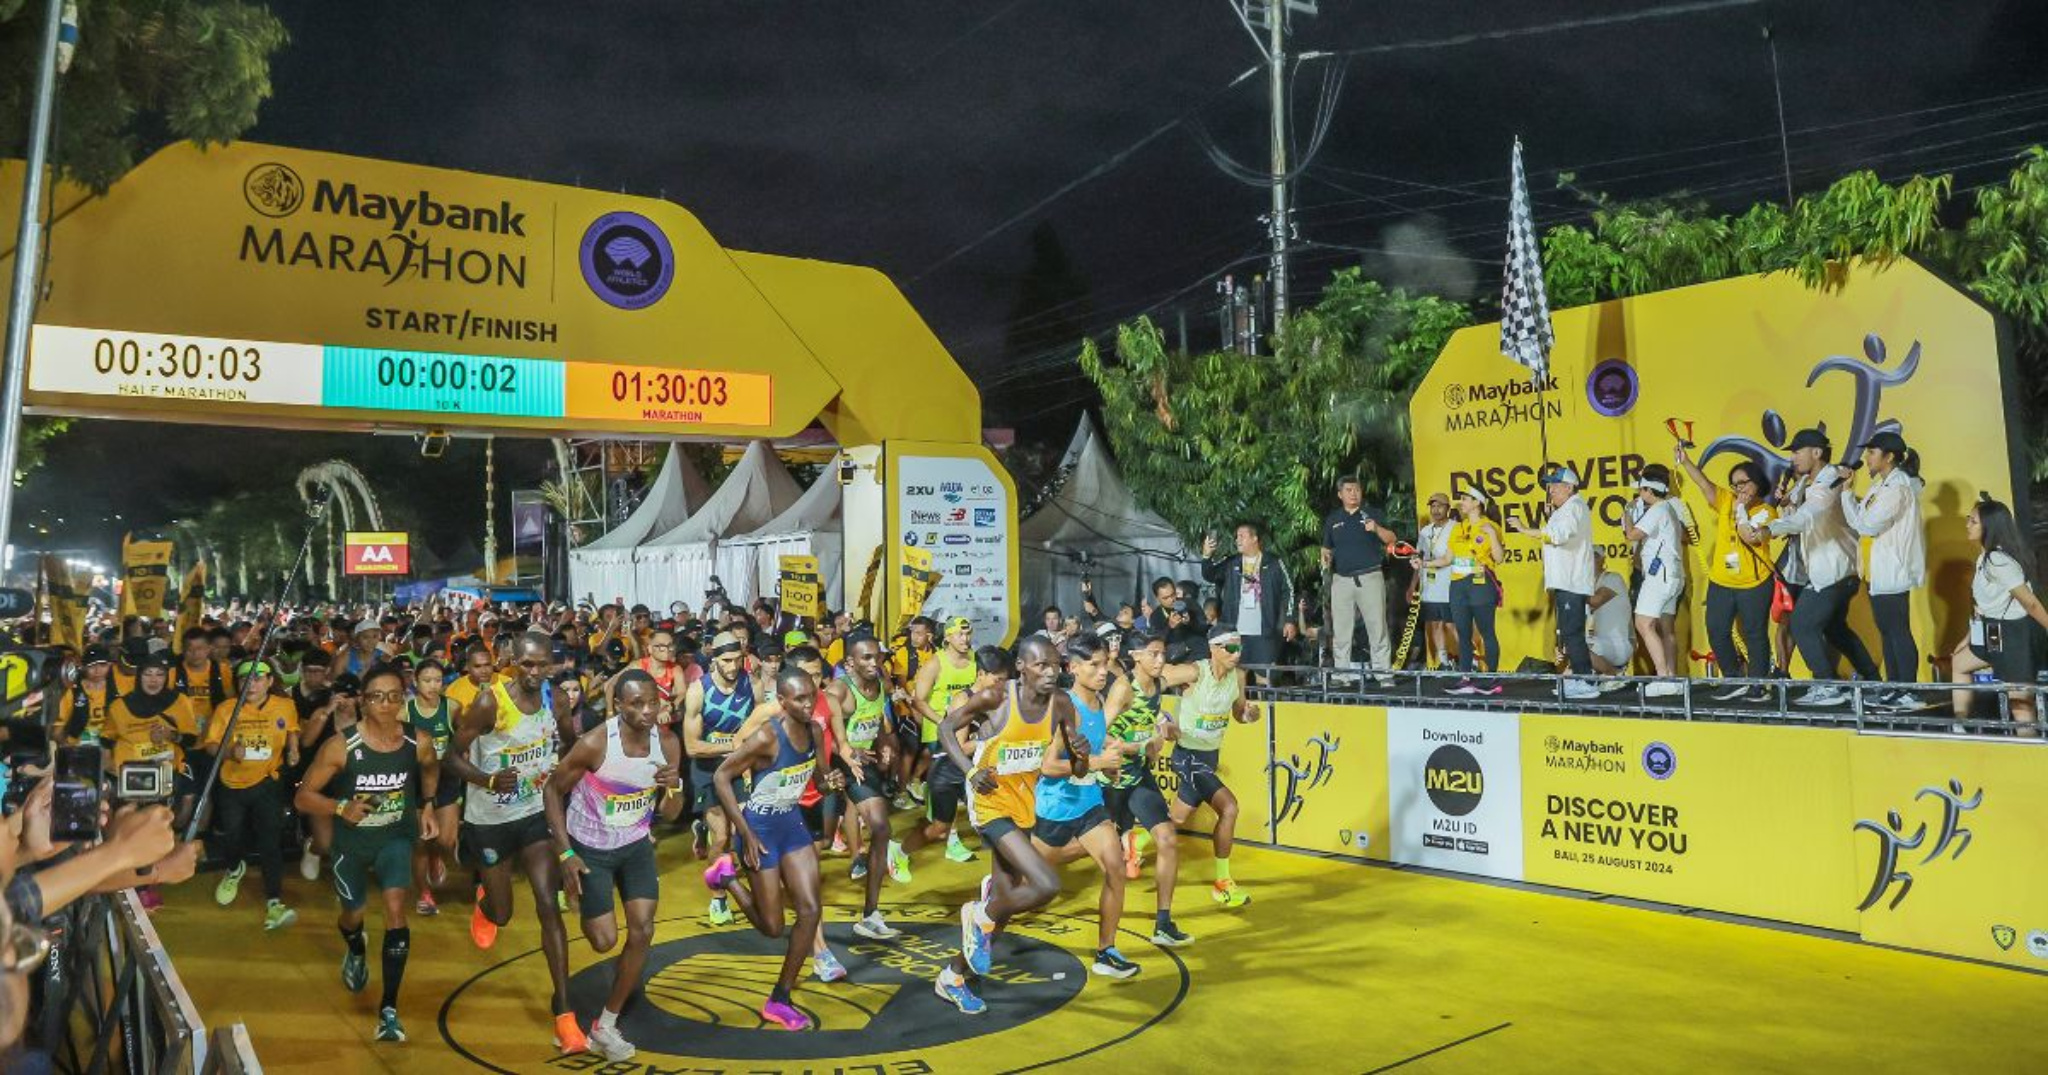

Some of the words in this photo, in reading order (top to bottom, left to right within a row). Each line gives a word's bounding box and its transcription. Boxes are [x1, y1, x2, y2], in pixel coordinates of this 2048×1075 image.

[312, 179, 526, 237] Maybank
[239, 225, 526, 288] MARATHON
[366, 308, 558, 343] START/FINISH
[95, 338, 262, 382] 00:30:03
[378, 356, 517, 393] 00:00:02
[164, 386, 247, 400] MARATHON
[612, 371, 728, 406] 01:30:03
[642, 408, 702, 422] MARATHON
[906, 486, 934, 495] 2XU
[361, 545, 393, 562] AA
[1422, 728, 1483, 745] Download
[1562, 739, 1624, 755] Maybank
[1545, 755, 1625, 773] MARATHON
[1426, 768, 1482, 793] M2U
[1547, 794, 1678, 828] DISCOVER
[1433, 819, 1459, 832] M2U
[1464, 822, 1477, 834] ID
[1541, 819, 1557, 839] A
[1564, 820, 1622, 847] NEW
[1629, 827, 1687, 855] YOU
[1554, 850, 1579, 863] BALI,
[1582, 853, 1595, 864] 25
[1598, 856, 1642, 870] AUGUST
[1645, 861, 1673, 874] 2024
